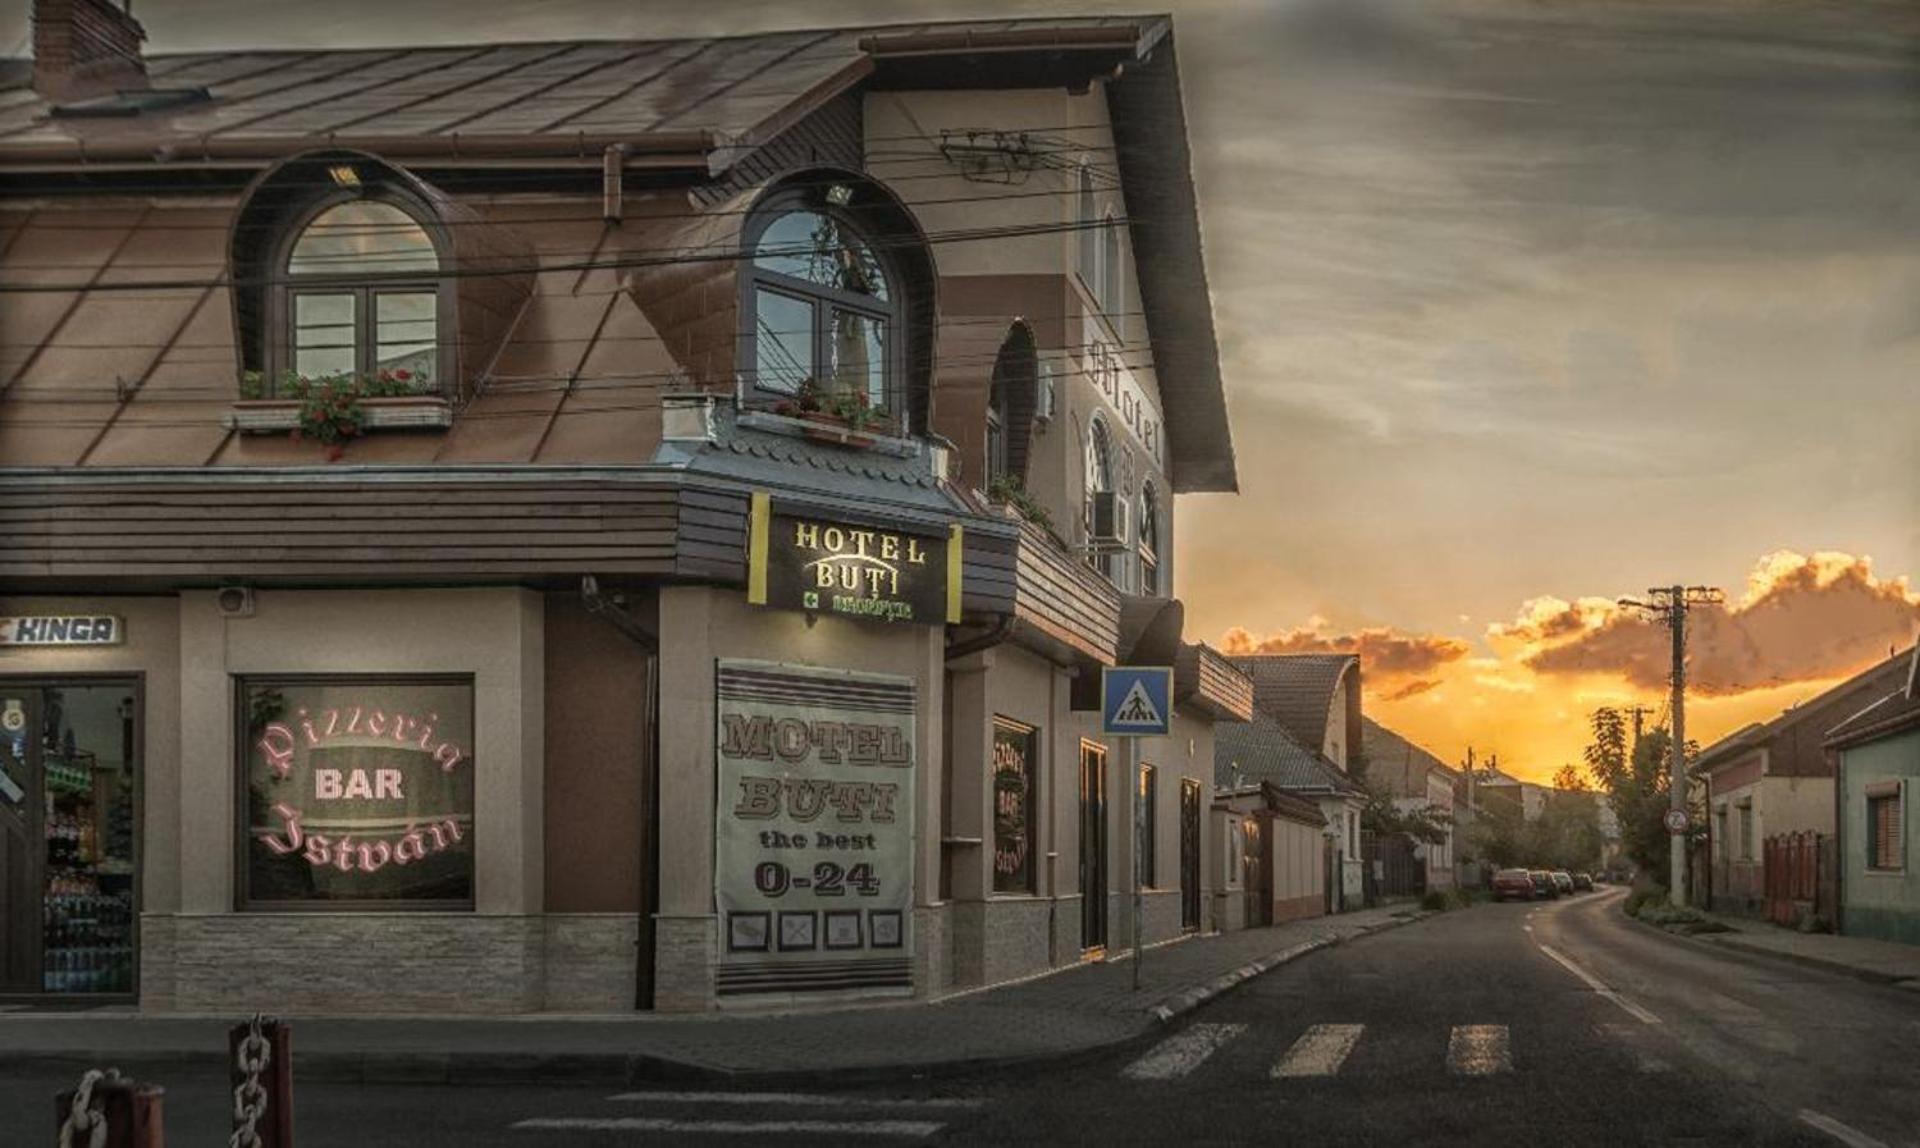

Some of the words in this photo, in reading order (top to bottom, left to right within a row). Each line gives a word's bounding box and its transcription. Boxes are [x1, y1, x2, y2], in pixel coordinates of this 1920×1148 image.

[796, 523, 925, 563] HOTEL
[17, 619, 112, 641] KINGA
[261, 707, 462, 777] Pizzeria
[721, 713, 914, 768] MOTEL
[314, 767, 405, 801] BAR
[733, 775, 898, 824] BUTI
[759, 830, 808, 850] the
[815, 831, 878, 851] best
[754, 861, 881, 898] 0-24
